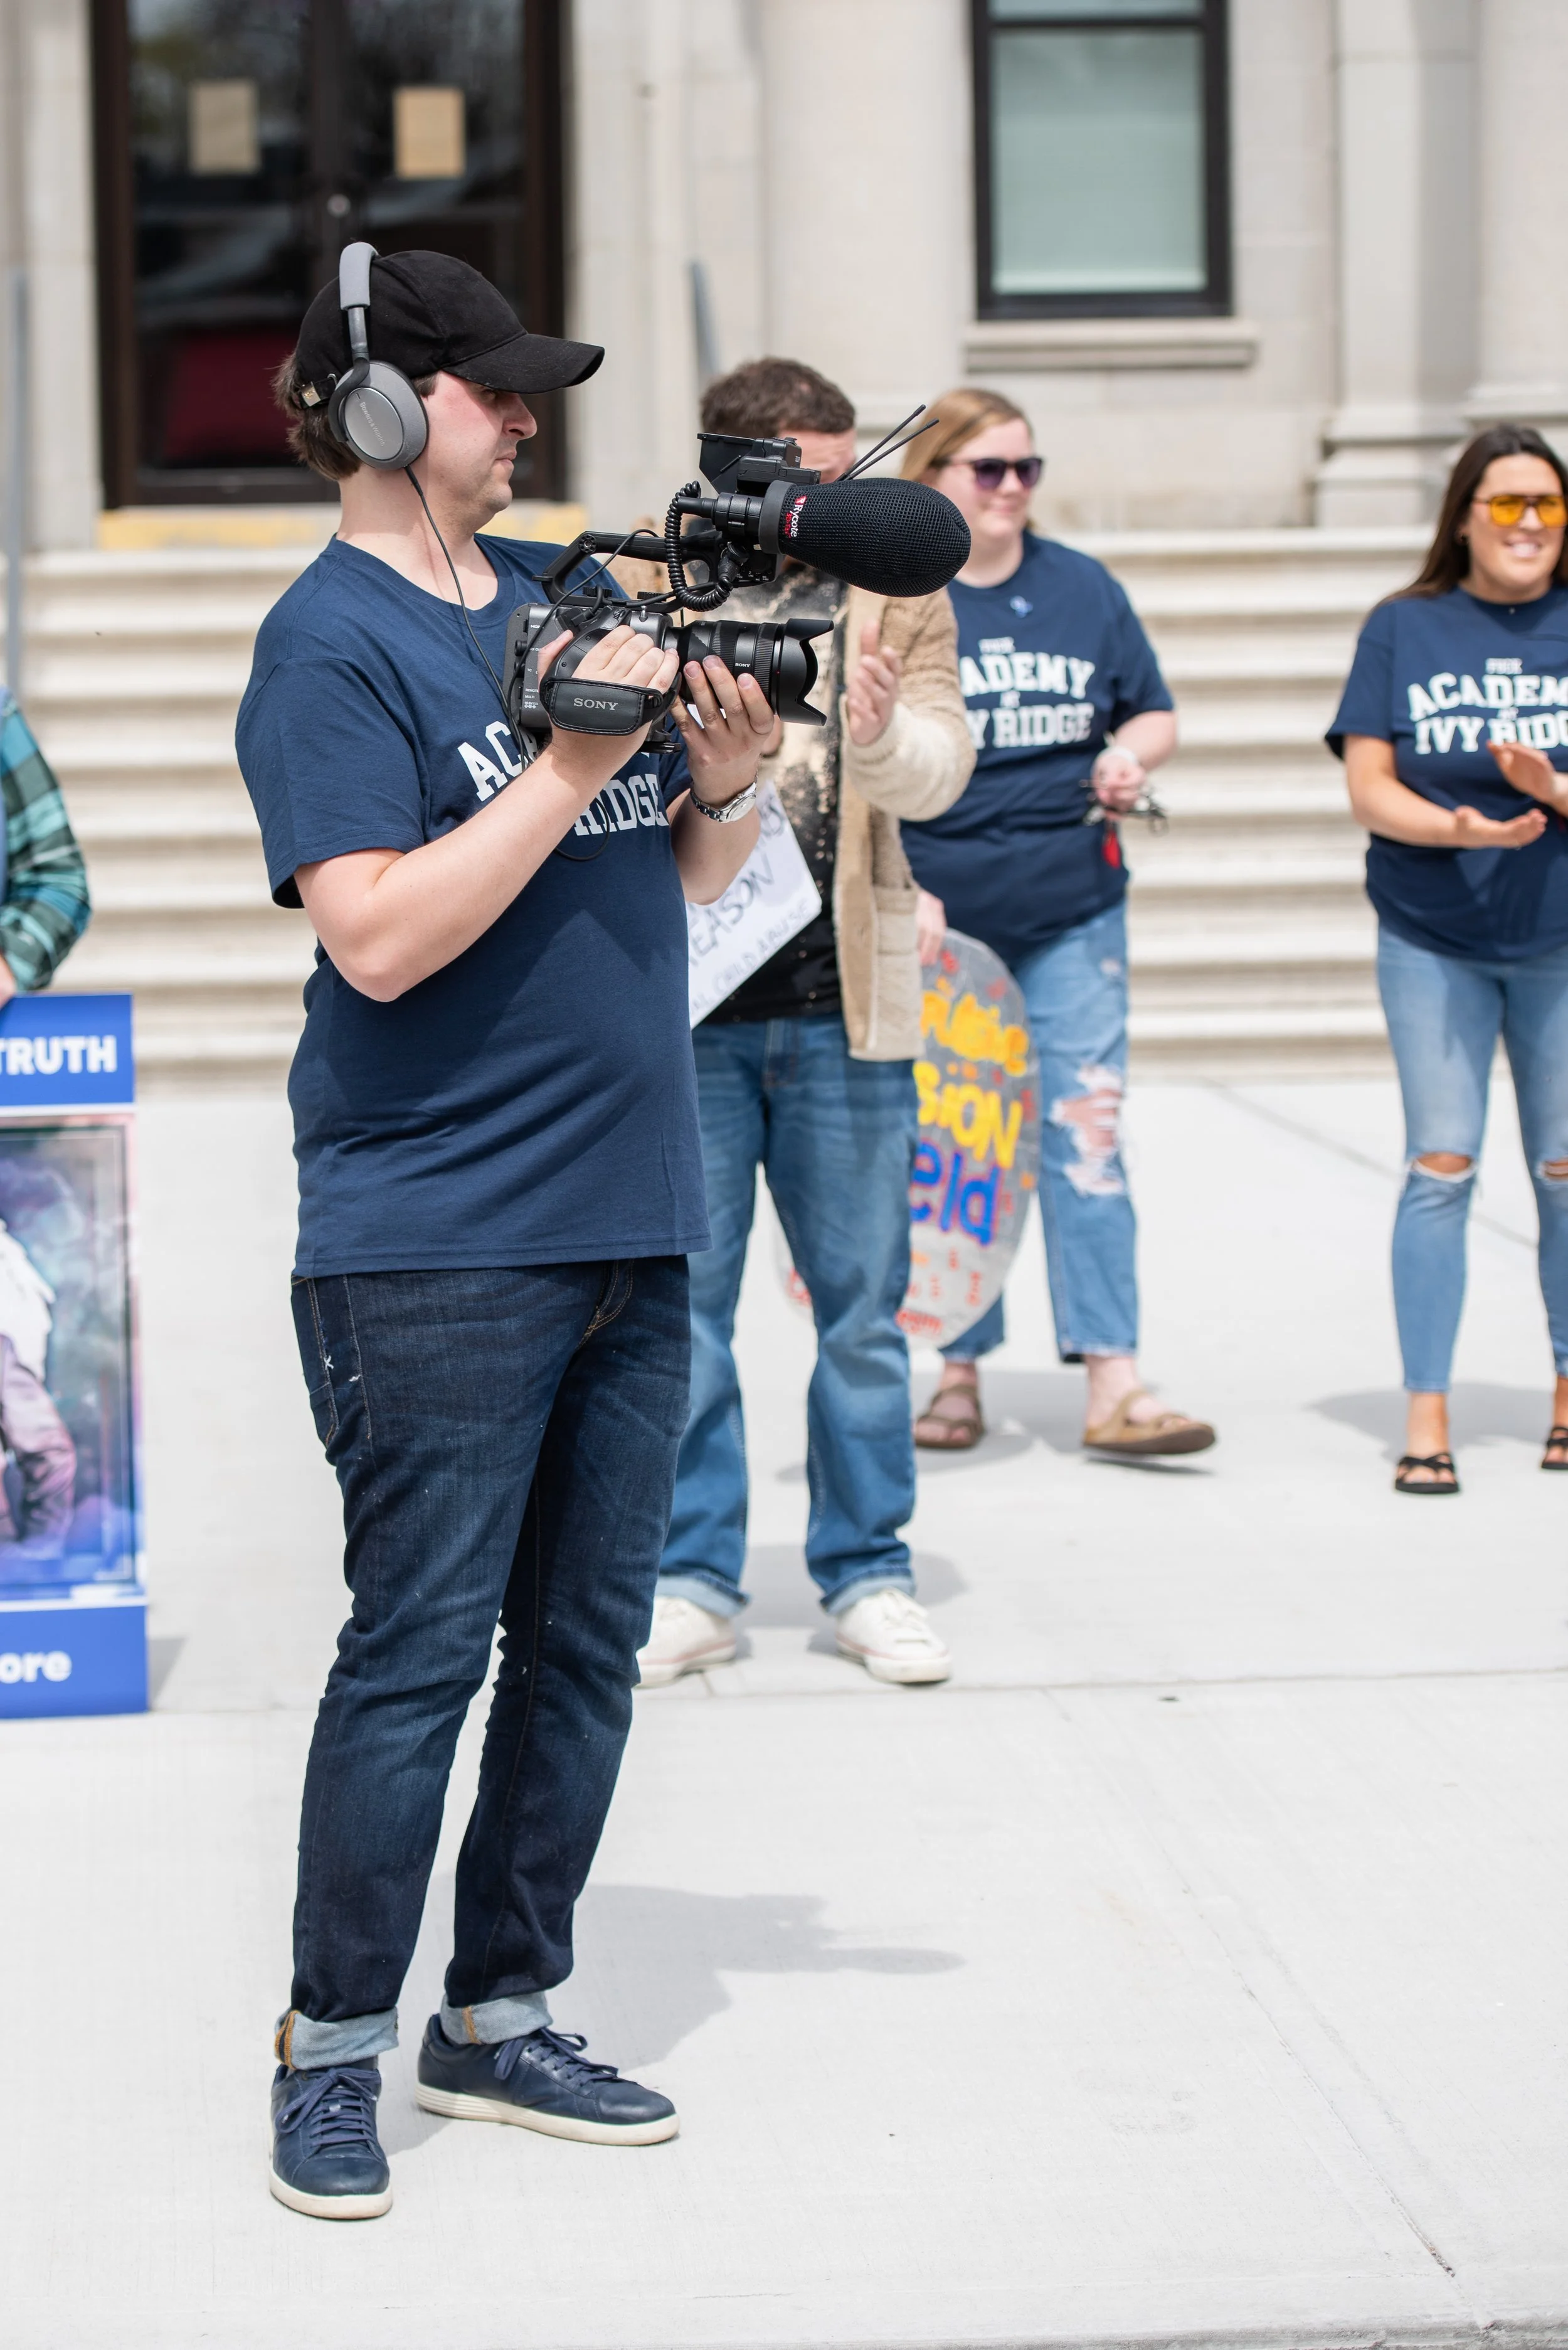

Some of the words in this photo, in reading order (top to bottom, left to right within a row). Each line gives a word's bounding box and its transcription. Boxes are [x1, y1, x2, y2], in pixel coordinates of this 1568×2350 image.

[360, 401, 373, 423] Bowers
[373, 426, 385, 446] Wilkins
[790, 504, 803, 537] Rycote
[573, 698, 619, 711] SONY
[991, 702, 1094, 748] RIDGE
[1414, 716, 1485, 755] IVY
[0, 1035, 117, 1075] RUTH
